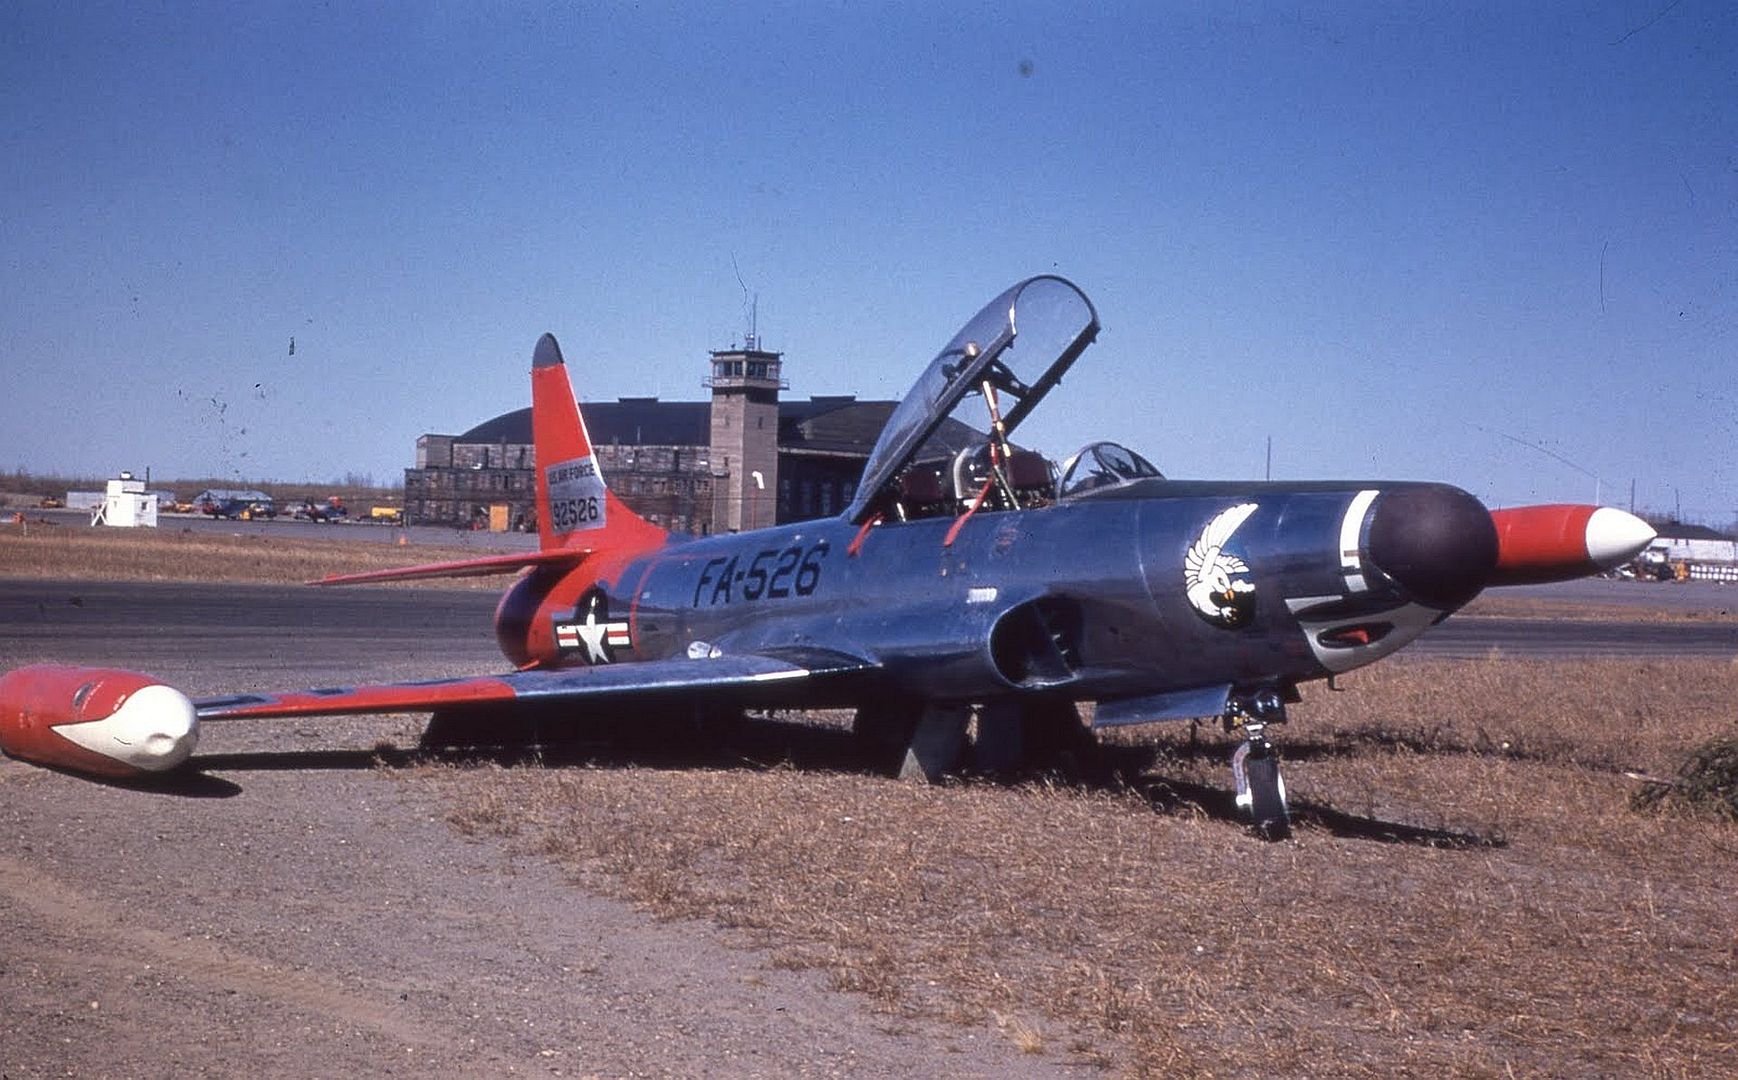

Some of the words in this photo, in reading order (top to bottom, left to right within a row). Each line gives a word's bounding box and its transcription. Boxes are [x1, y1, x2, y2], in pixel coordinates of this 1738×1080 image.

[569, 462, 596, 481] FORCE
[553, 496, 598, 526] 92526
[693, 543, 830, 608] FA-526
